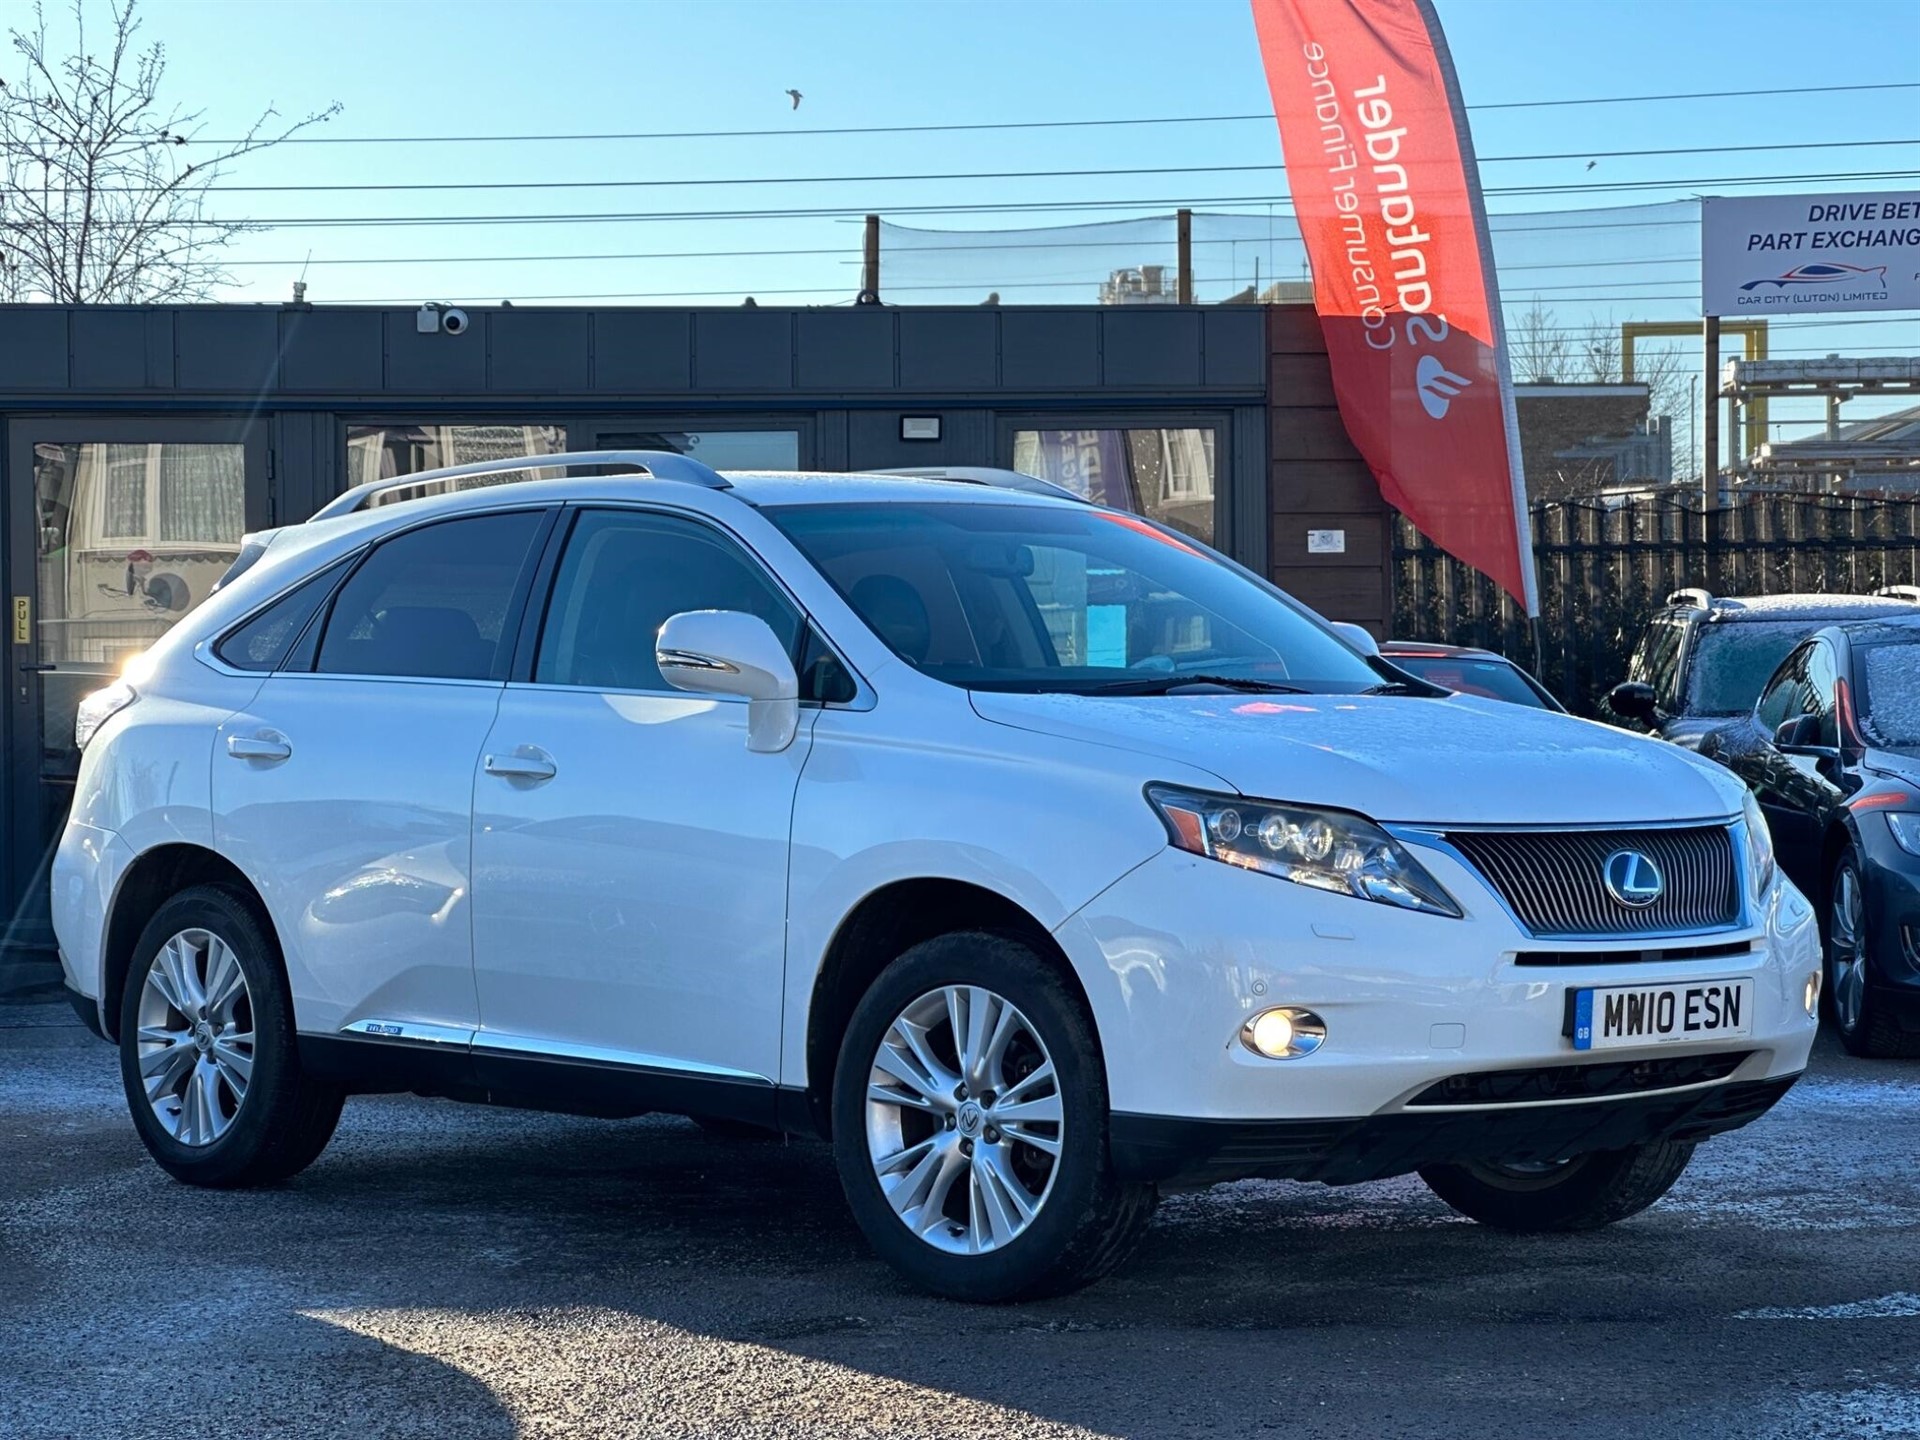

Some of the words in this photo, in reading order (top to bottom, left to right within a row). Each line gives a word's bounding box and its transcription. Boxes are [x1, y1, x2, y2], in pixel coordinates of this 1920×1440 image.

[1808, 203, 1877, 222] DRIVE
[1747, 232, 1807, 251] PART
[1810, 228, 1920, 249] EXCHANG
[1737, 296, 1761, 304] CAR
[1764, 295, 1790, 304] CITY
[1793, 293, 1840, 304] (LUTON)
[1843, 291, 1888, 301] LIMITED
[18, 600, 26, 640] PULL
[1684, 985, 1741, 1031] ESN
[1577, 1027, 1589, 1039] GB
